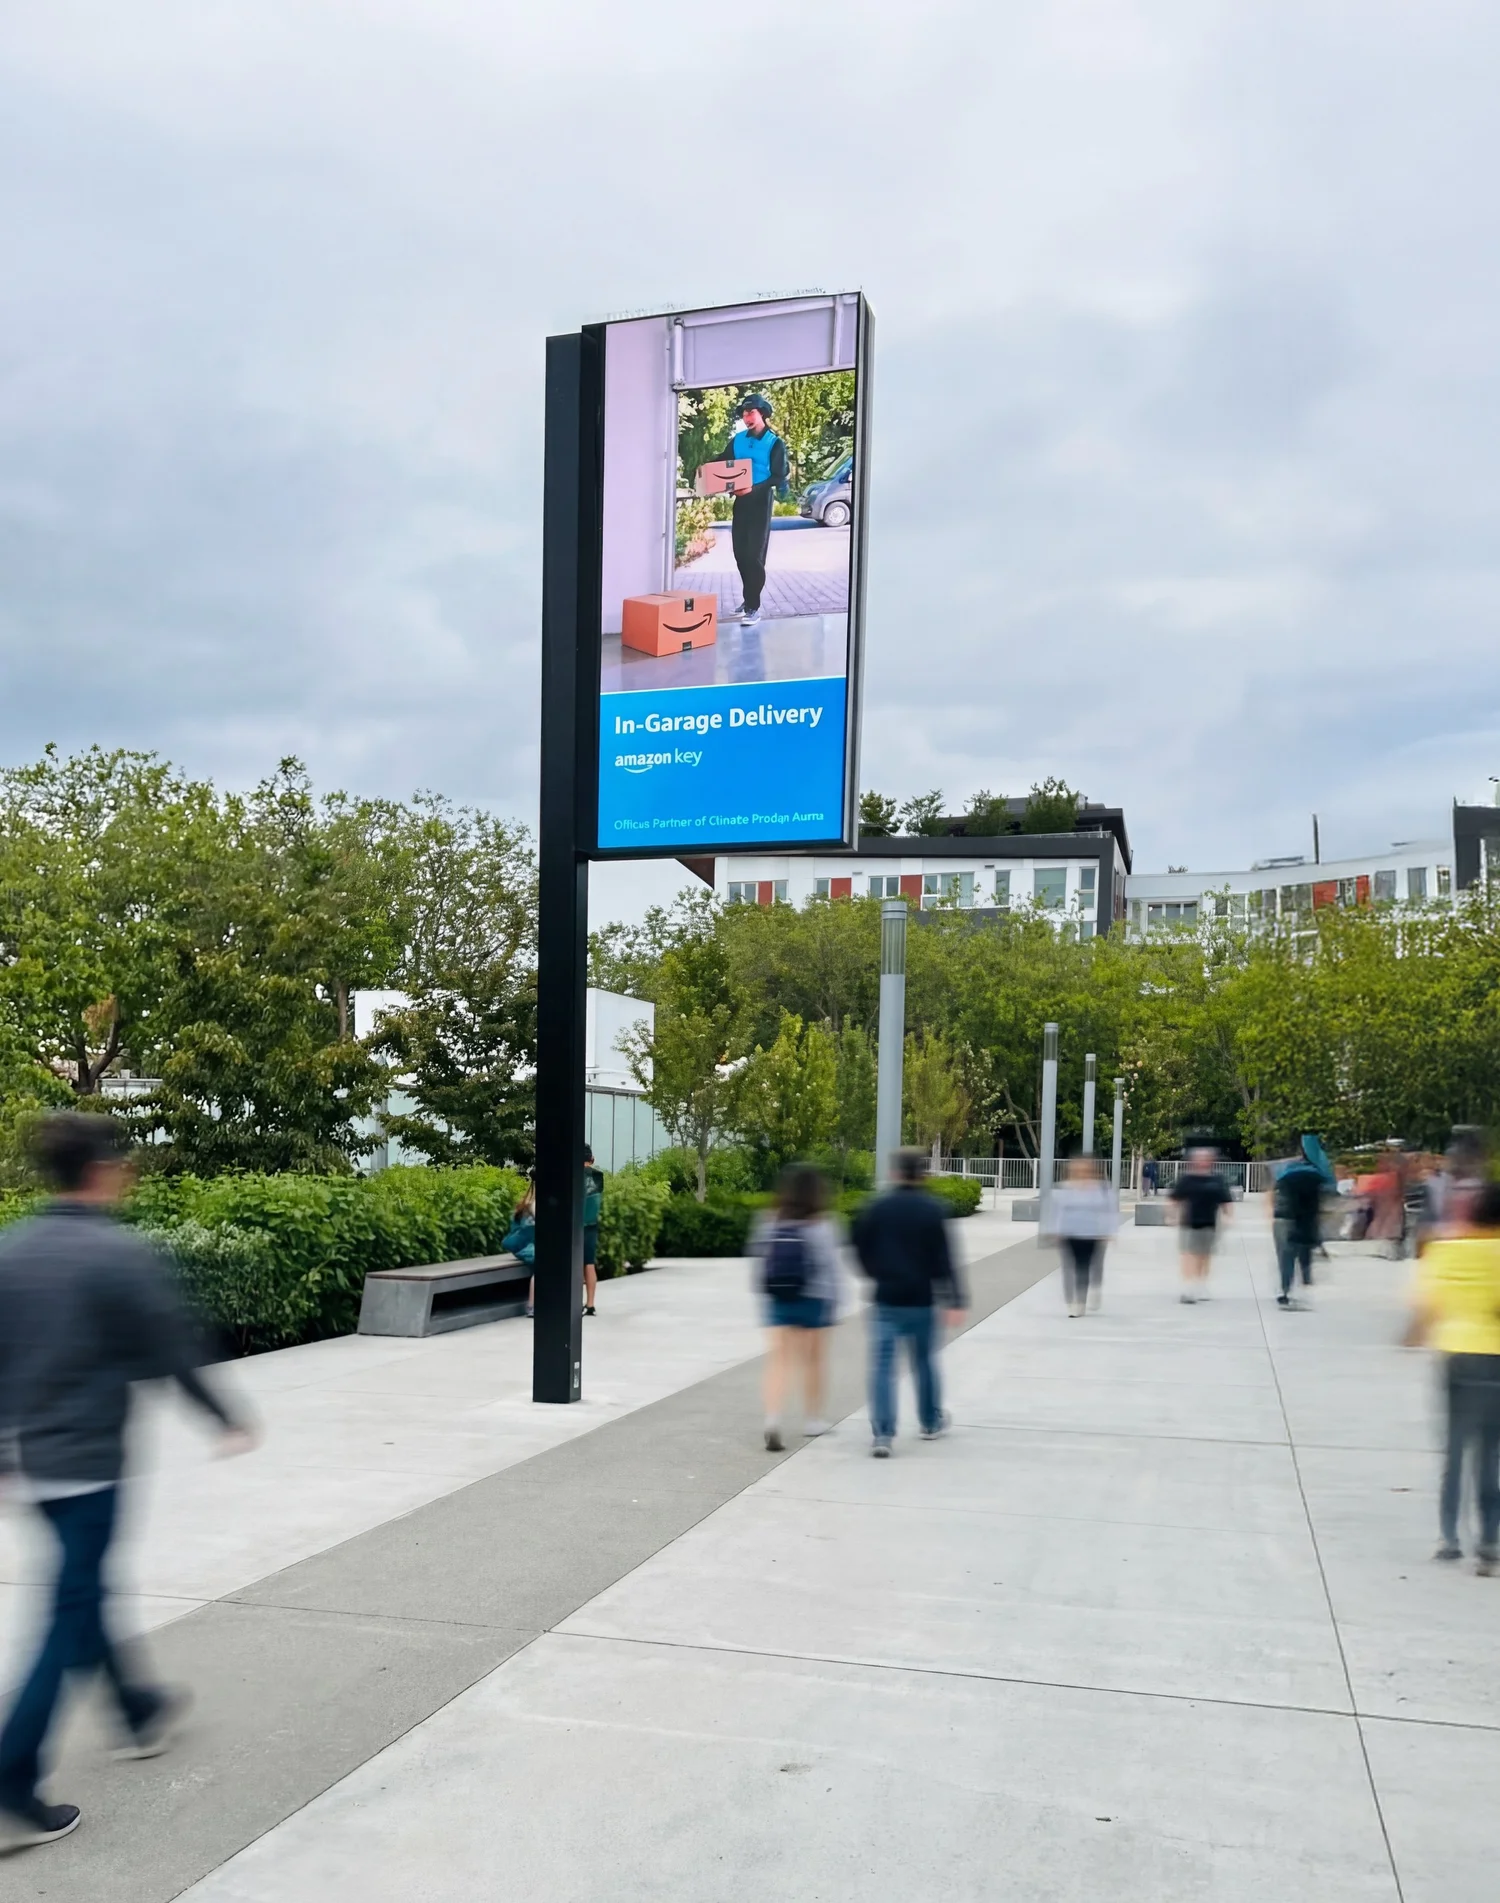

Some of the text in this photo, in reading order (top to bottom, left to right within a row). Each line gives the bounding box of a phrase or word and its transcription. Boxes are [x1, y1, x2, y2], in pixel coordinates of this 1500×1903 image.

[615, 704, 824, 735] In-Garage Delivery
[615, 748, 703, 771] amazon key
[653, 818, 692, 829] Partner
[695, 815, 707, 827] of
